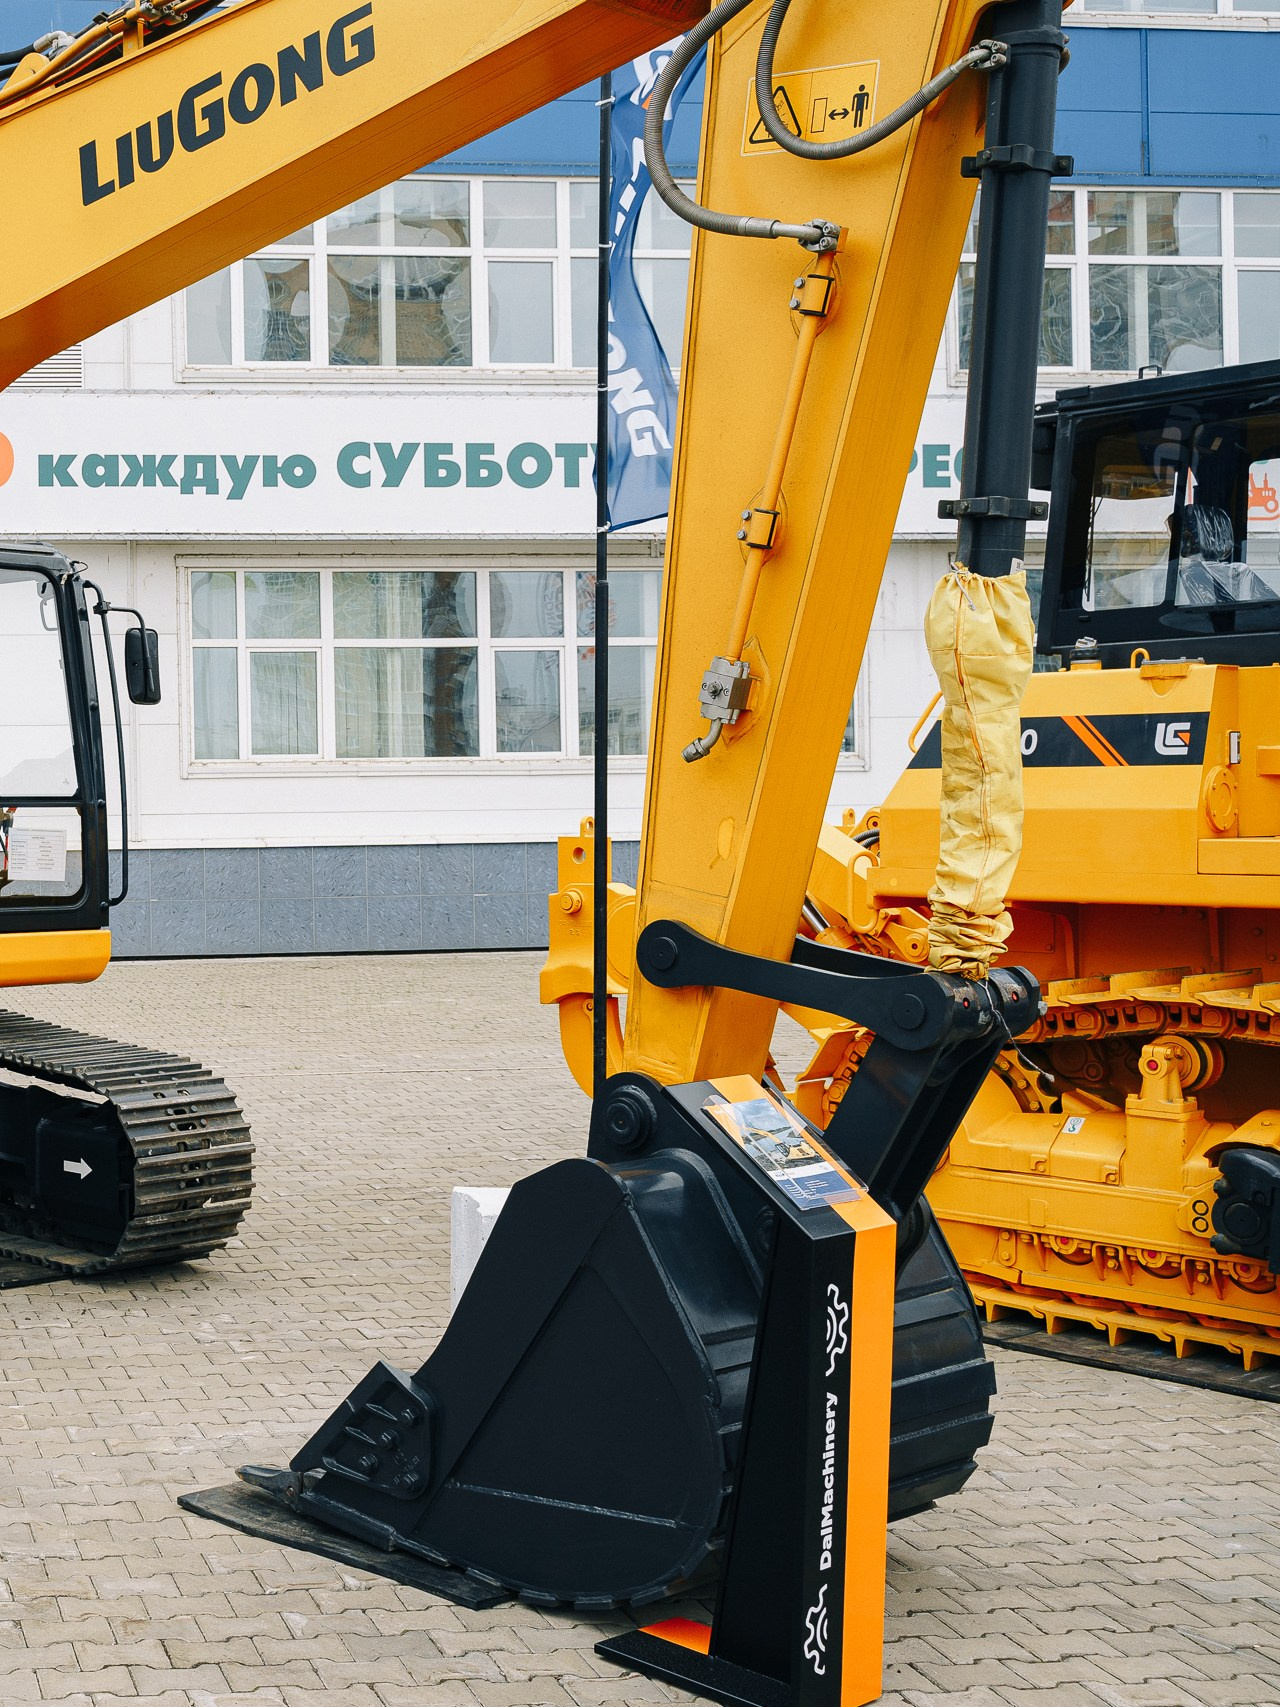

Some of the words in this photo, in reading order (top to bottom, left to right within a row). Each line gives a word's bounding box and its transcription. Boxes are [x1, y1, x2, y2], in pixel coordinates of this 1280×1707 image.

[37, 452, 317, 500] каждую
[336, 441, 597, 489] СУББОТ
[819, 1391, 839, 1572] DalMachinery
